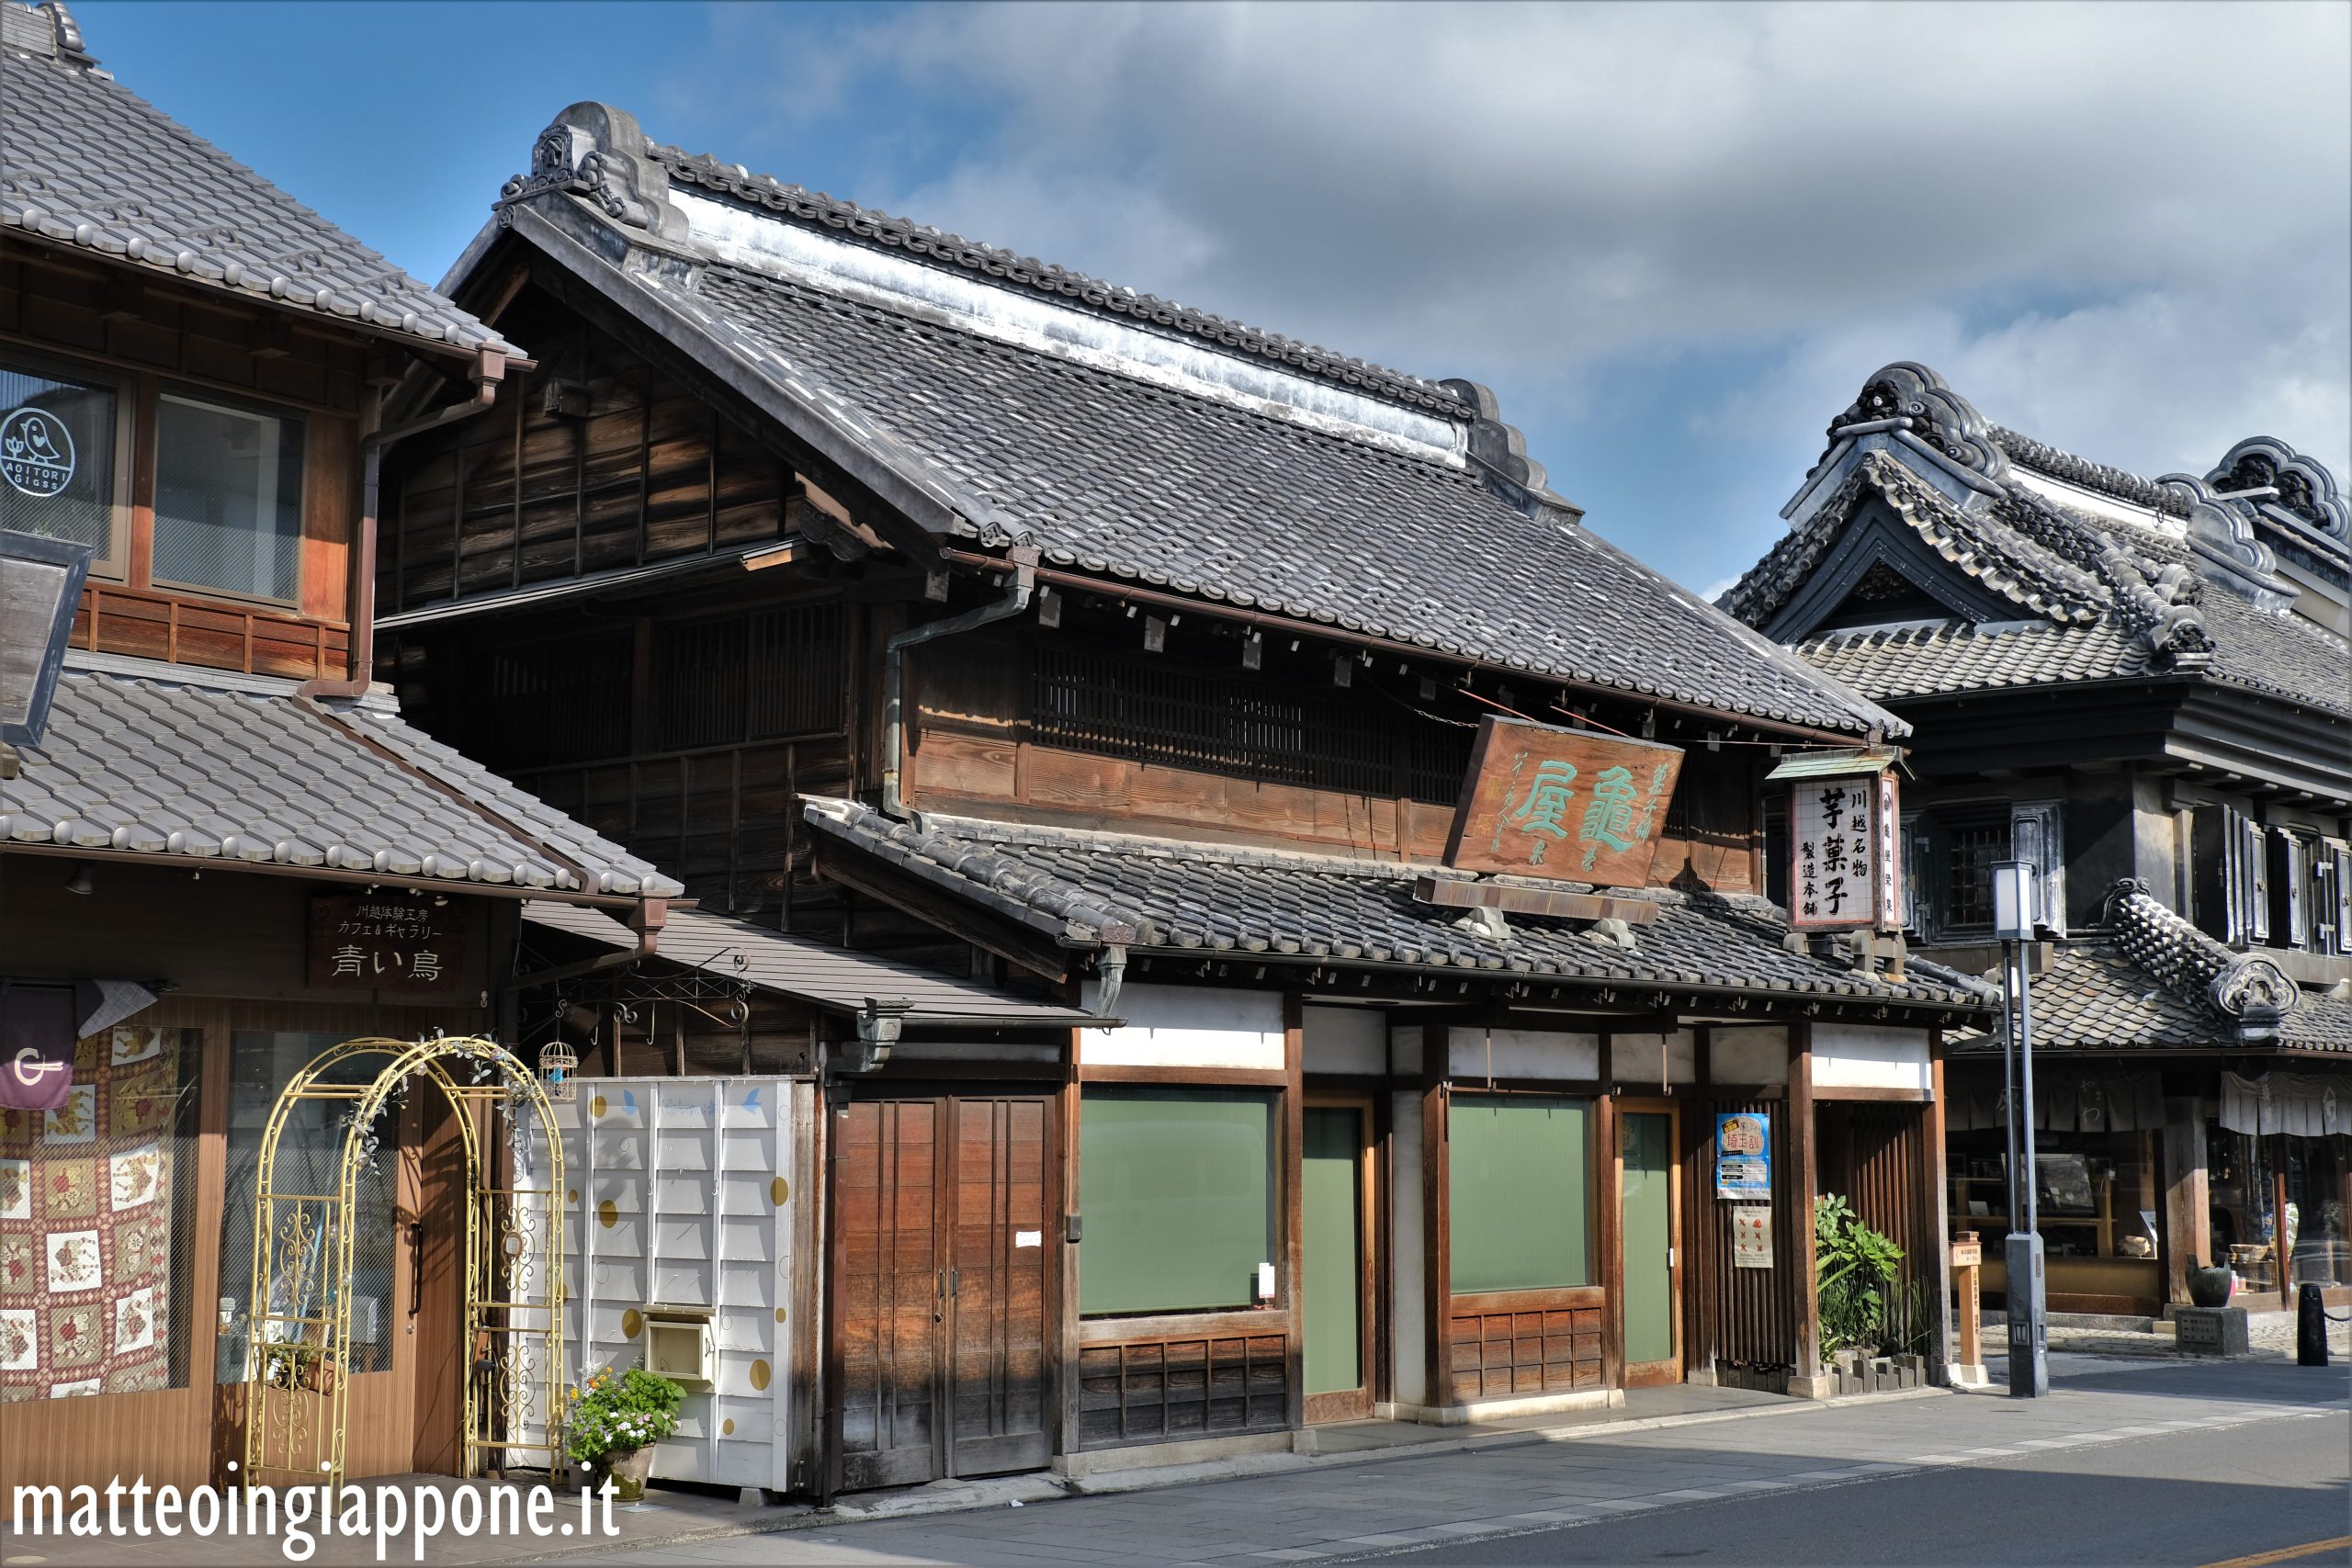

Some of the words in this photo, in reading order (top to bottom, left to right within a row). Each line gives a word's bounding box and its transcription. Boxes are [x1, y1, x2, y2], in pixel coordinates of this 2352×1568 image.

[6, 464, 66, 482] AOITORI
[15, 474, 59, 491] GIGSS
[1849, 790, 1869, 878] 川越名物
[1819, 787, 1849, 916] 芋菓子
[1801, 841, 1819, 917] 製造本舗
[356, 905, 429, 922] 川越体験工房
[337, 920, 442, 939] カフェ&ギャラリー
[331, 944, 445, 982] 青い鳥
[1726, 1133, 1760, 1149] 埼玉割
